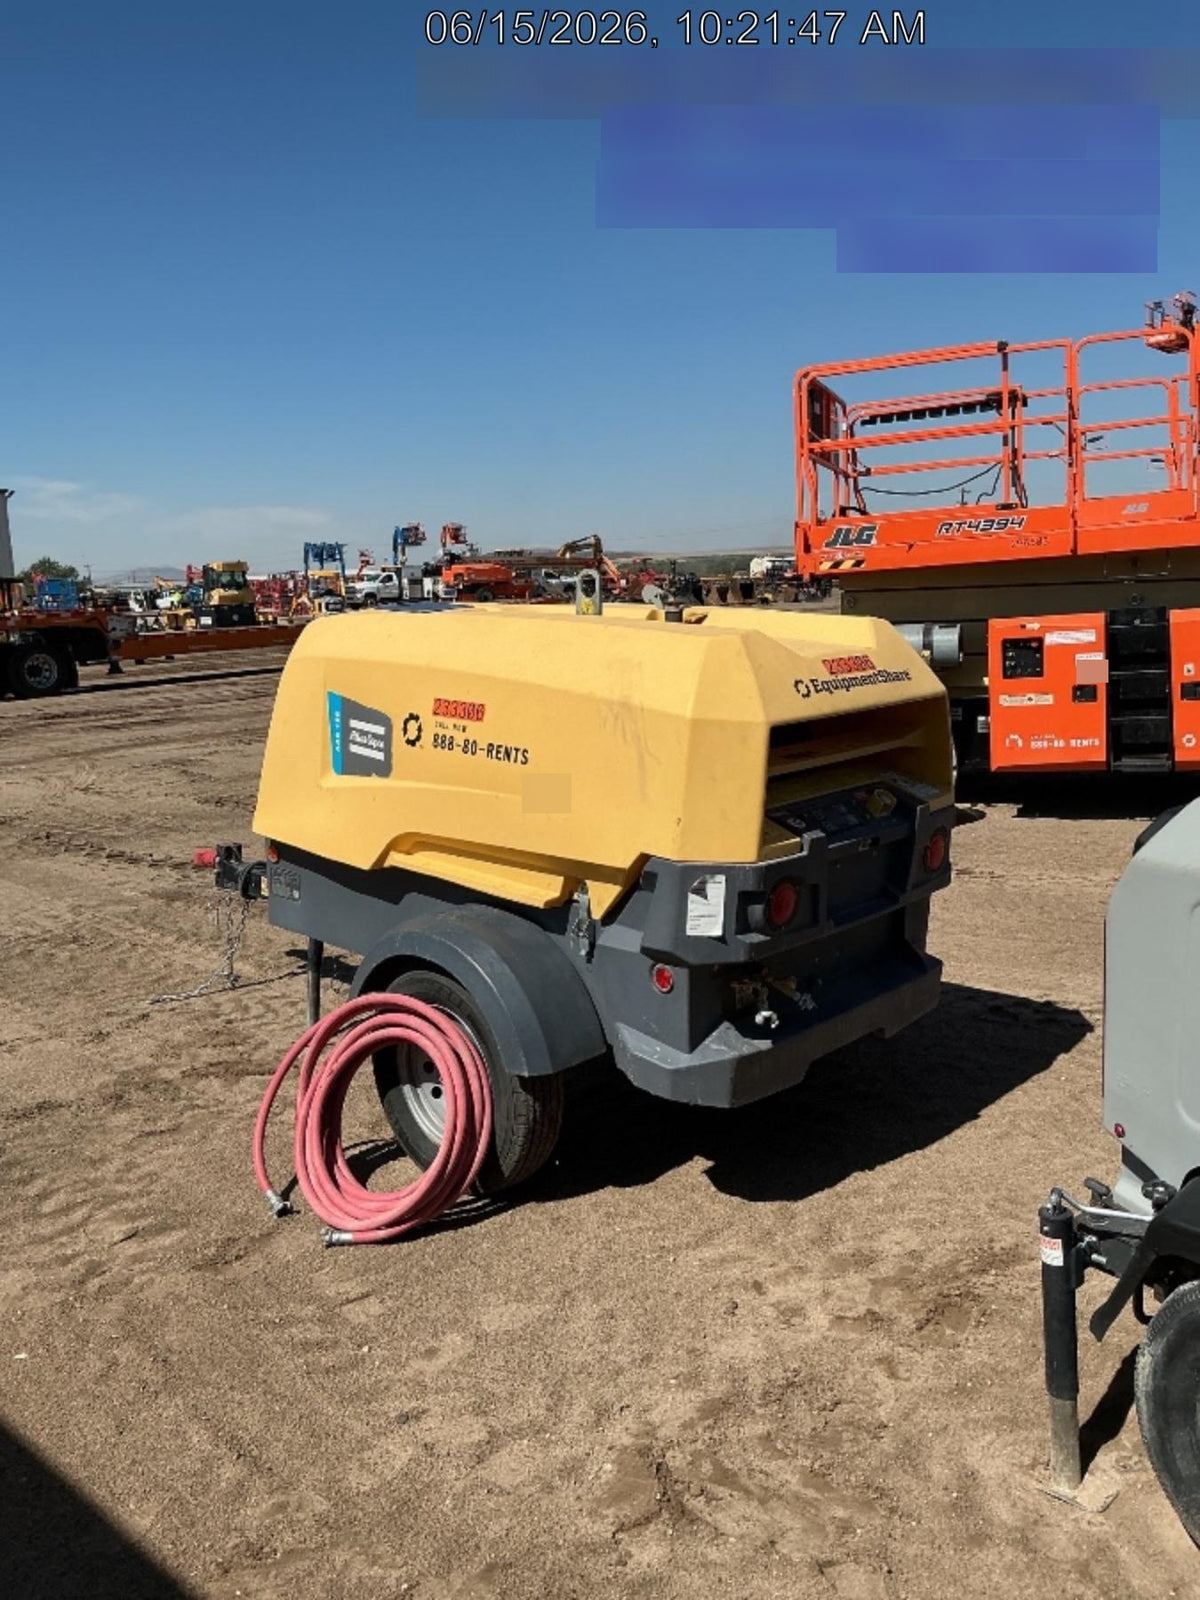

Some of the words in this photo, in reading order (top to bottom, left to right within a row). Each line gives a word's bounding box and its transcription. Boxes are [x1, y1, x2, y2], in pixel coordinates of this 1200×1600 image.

[824, 524, 878, 548] JLG
[937, 515, 1028, 537] RT4394
[809, 668, 912, 695] EquipmentShare
[432, 732, 530, 766] 888-80-RENTS
